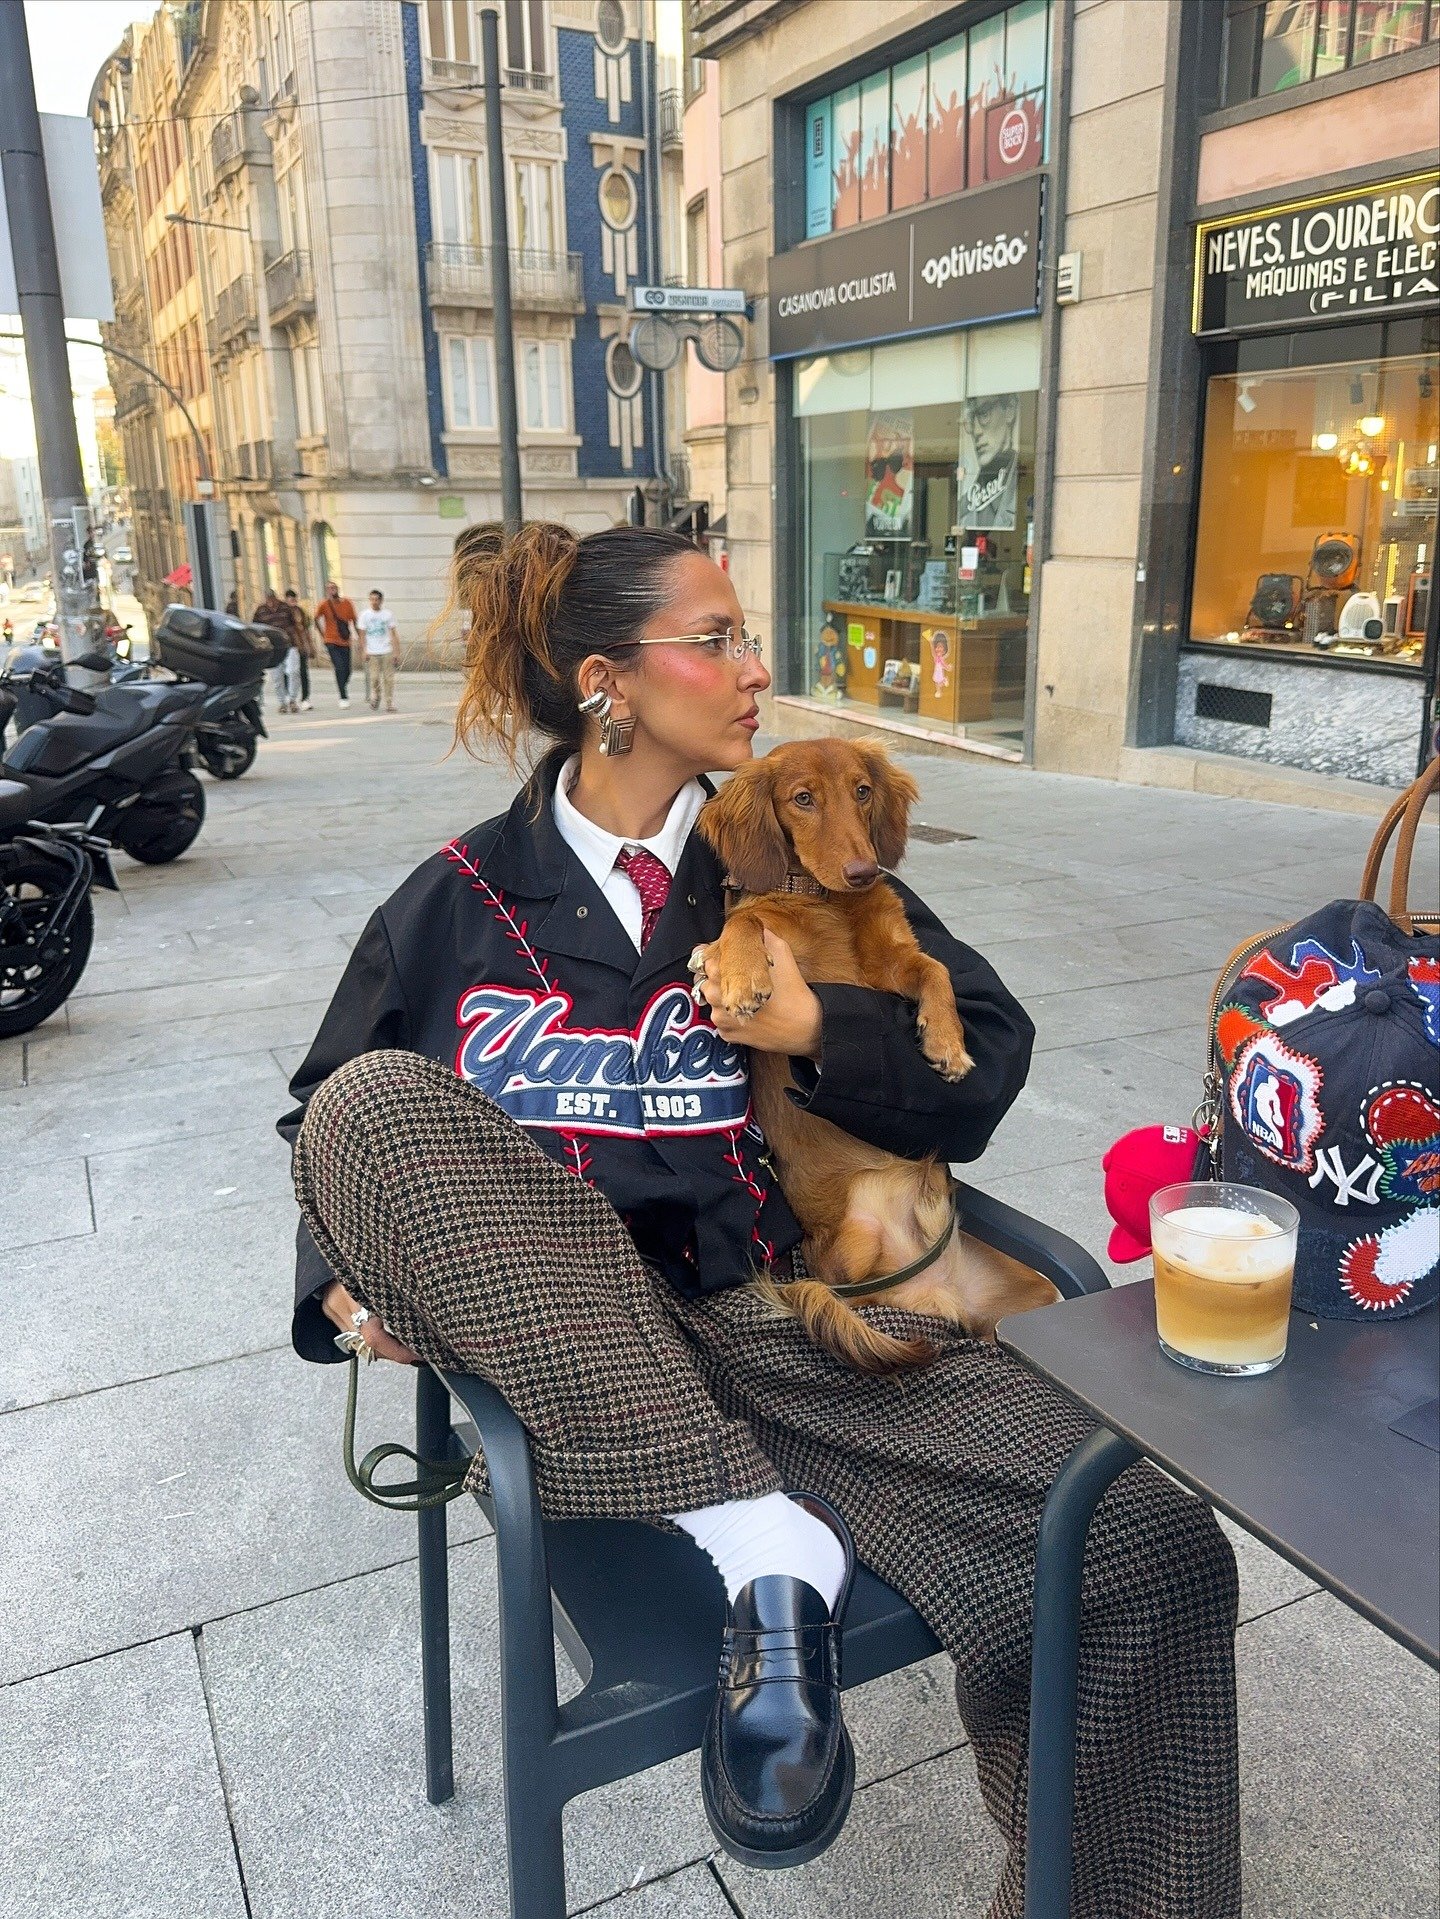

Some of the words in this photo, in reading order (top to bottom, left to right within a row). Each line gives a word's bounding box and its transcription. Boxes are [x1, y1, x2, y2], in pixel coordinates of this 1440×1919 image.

[1290, 186, 1440, 260] LOUREIRO
[921, 233, 1028, 288] optivisão
[1245, 256, 1347, 300] MÁQUINAS
[1353, 257, 1369, 282] E
[1375, 240, 1440, 279] ELEC
[778, 285, 837, 318] CASANOVA
[837, 270, 897, 303] OCULISTA
[457, 983, 750, 1099] Yankee
[556, 1092, 618, 1119] EST.
[642, 1094, 702, 1119] 1903
[1251, 1120, 1278, 1145] NBA
[1308, 1144, 1385, 1207] NY
